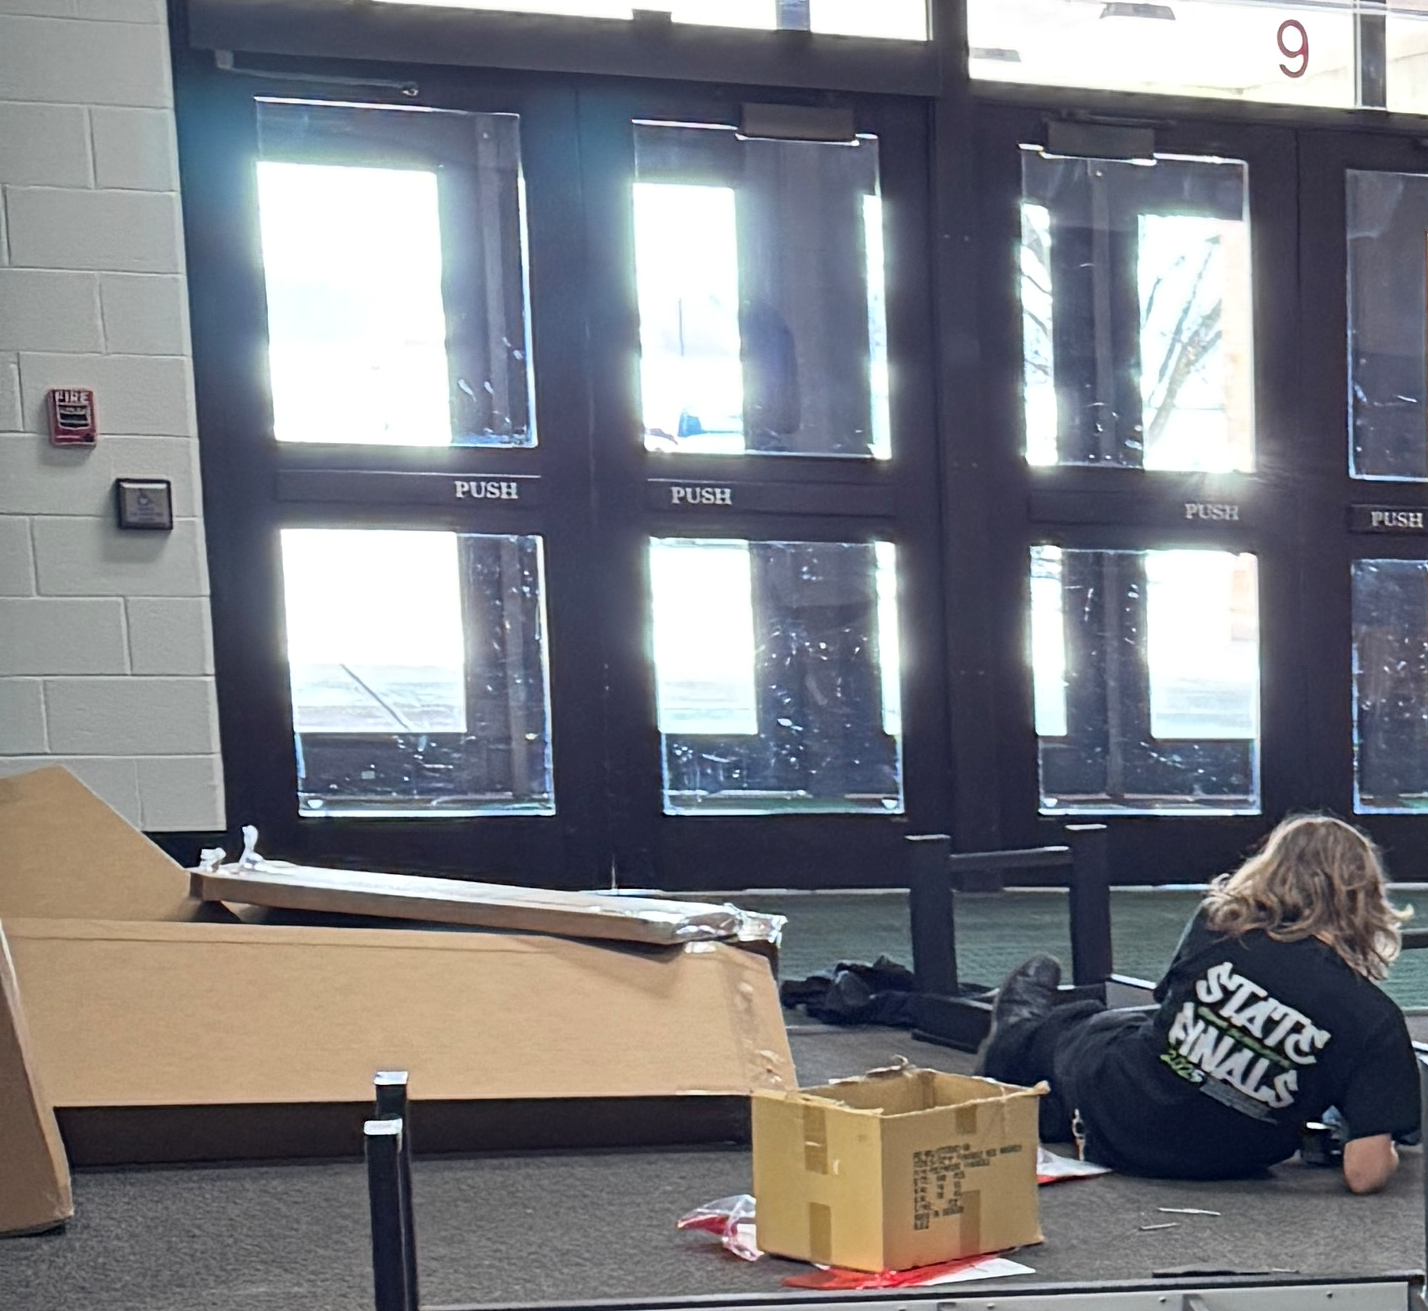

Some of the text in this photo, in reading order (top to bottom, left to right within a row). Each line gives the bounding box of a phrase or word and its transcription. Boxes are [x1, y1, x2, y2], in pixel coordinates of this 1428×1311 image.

[1276, 18, 1310, 79] 9
[54, 391, 90, 403] FIRE
[454, 480, 519, 500] PUSH
[670, 486, 733, 505] PUSH
[1184, 503, 1240, 521] PUSH
[1370, 511, 1424, 529] PUSH
[1195, 961, 1332, 1066] STATE
[1168, 1001, 1299, 1109] FINALS
